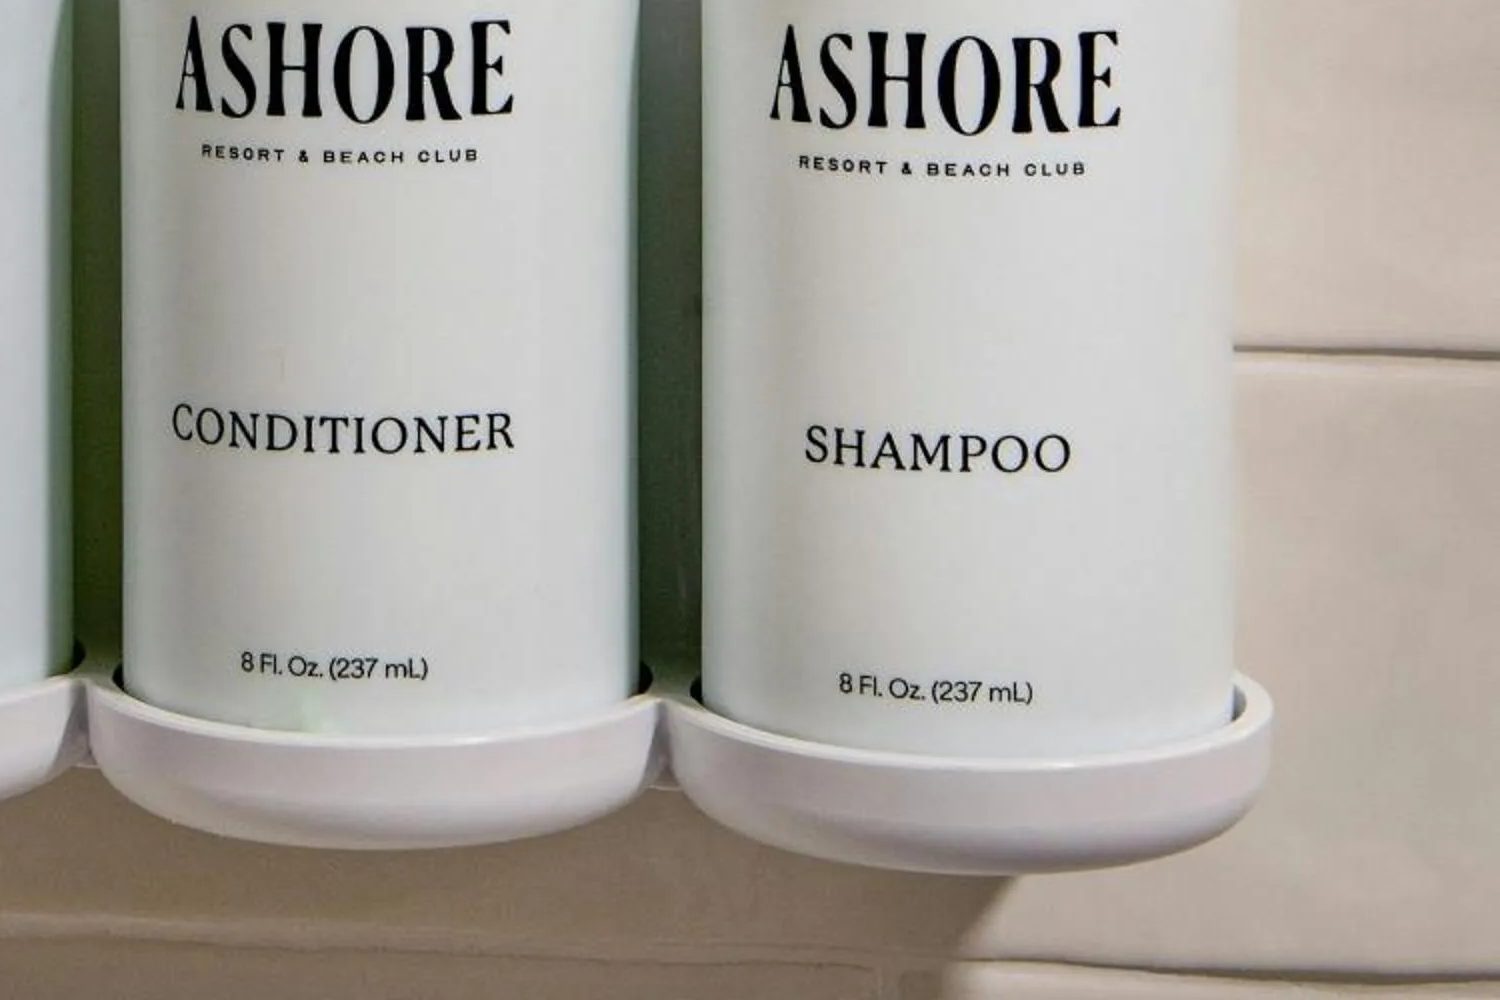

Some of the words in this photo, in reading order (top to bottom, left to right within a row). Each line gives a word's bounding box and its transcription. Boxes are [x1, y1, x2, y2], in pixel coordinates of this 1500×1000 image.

[175, 16, 515, 124] ASHORE
[770, 24, 1121, 136] ASHORE
[201, 143, 285, 163] RESORT
[298, 150, 310, 164] &
[323, 149, 405, 165] BEACH
[417, 148, 479, 164] CLUB
[798, 154, 889, 175] RESORT
[900, 161, 913, 176] &
[926, 162, 1010, 178] BEACH
[1023, 161, 1086, 177] CLUB
[171, 403, 515, 455] CONDITIONER
[804, 424, 1072, 474] SHAMPOO
[240, 650, 254, 673] 8
[259, 653, 283, 676] Fl.
[287, 655, 324, 678] Oz.
[329, 656, 379, 682] (237
[384, 656, 429, 681] mL)
[838, 672, 853, 694] 8
[858, 675, 883, 697] Fl.
[888, 676, 926, 701] Oz.
[931, 680, 983, 705] (237
[988, 681, 1034, 706] mL)
